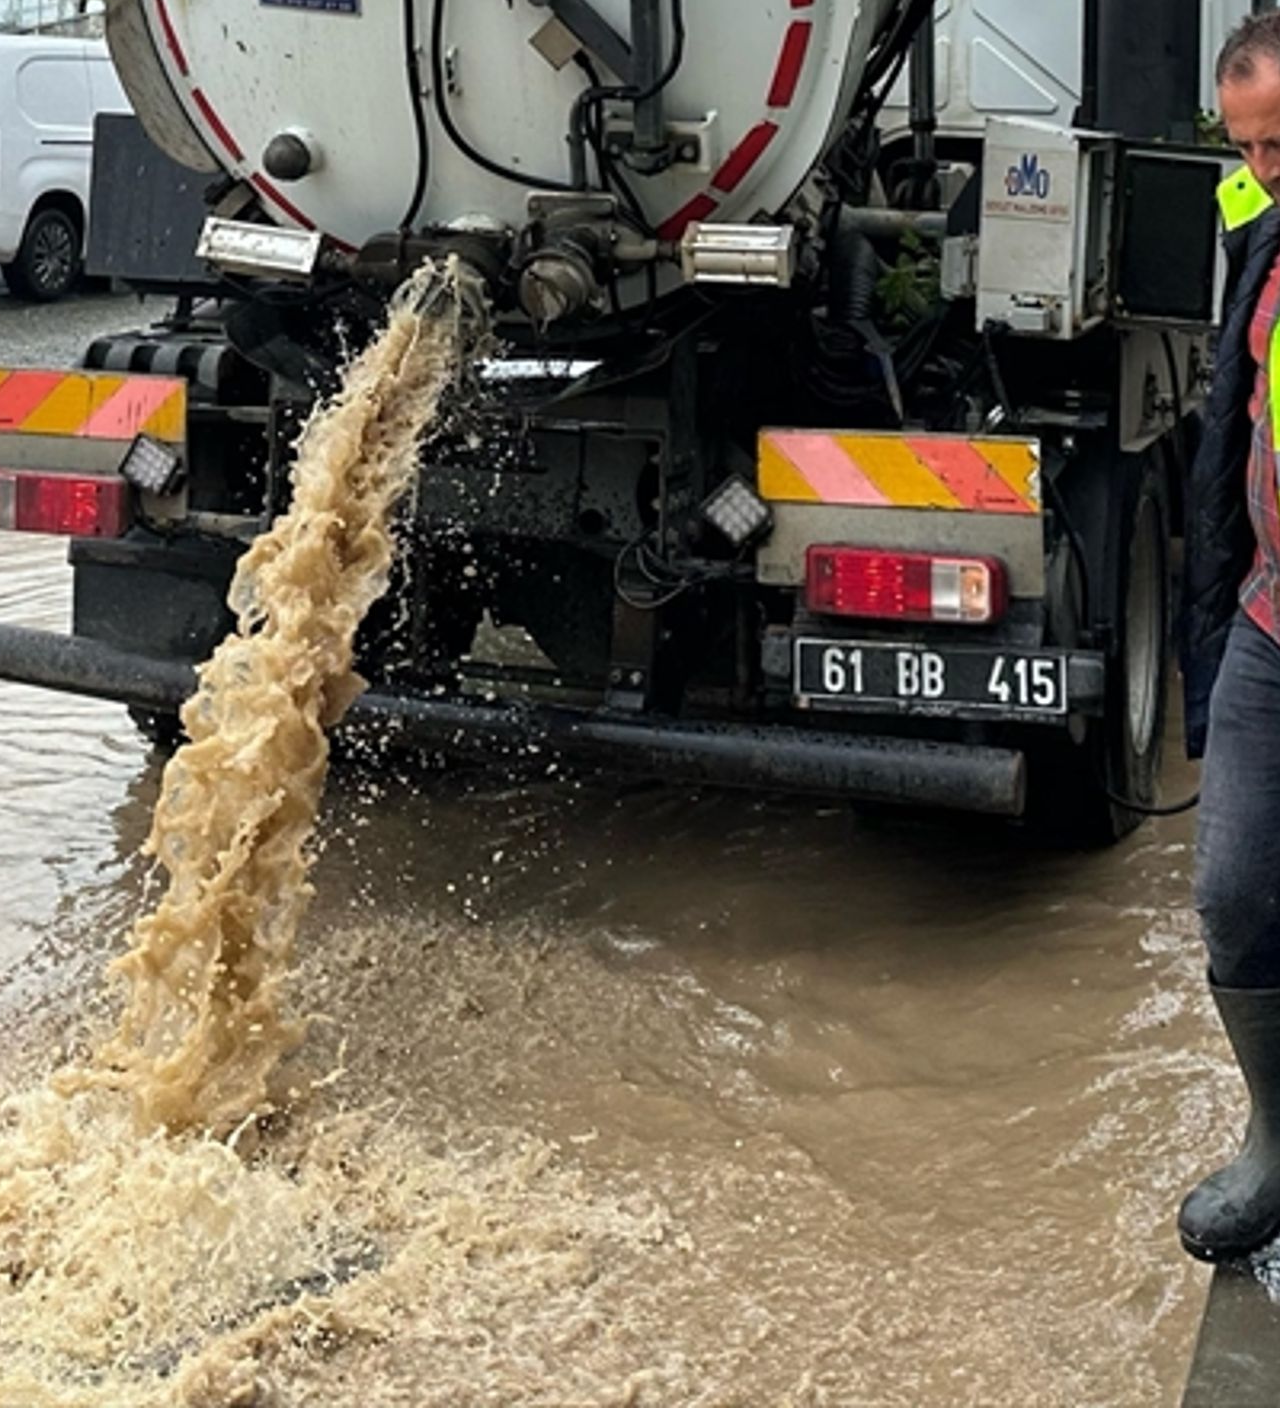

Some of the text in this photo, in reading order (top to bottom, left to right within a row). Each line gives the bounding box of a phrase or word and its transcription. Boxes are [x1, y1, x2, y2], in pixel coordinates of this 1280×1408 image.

[823, 647, 1056, 706] 61 BB 415
